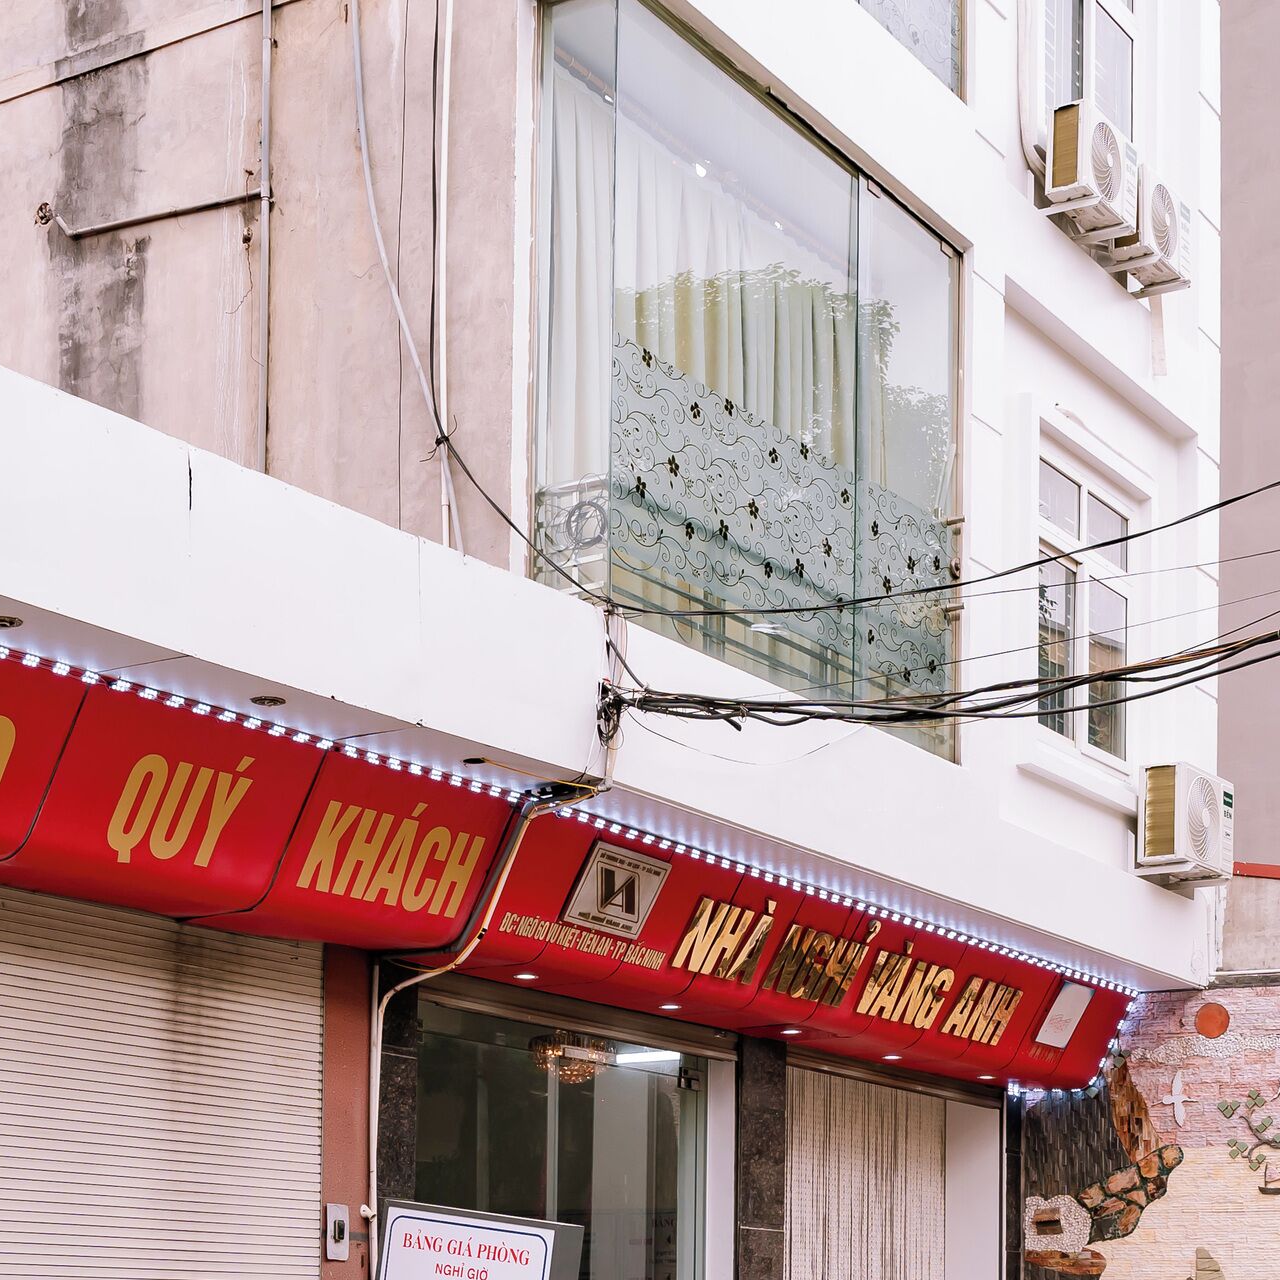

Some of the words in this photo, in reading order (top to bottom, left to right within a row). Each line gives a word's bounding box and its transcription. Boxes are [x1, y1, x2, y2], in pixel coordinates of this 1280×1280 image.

[106, 754, 255, 867] QUÝ
[296, 800, 487, 918] KHÁCH
[533, 921, 549, 940] 60
[593, 936, 612, 957] AN
[639, 948, 666, 970] NINH
[671, 897, 777, 985] NHÀ
[762, 919, 882, 1008] NGHỈ
[856, 939, 955, 1030] VÀNG
[940, 976, 1024, 1046] ANH
[402, 1229, 443, 1253] BẢNG
[447, 1237, 472, 1258] GIÁ
[476, 1241, 530, 1266] PHÒNG
[434, 1262, 464, 1279] NGHỈ
[467, 1266, 489, 1280] GIỜ
